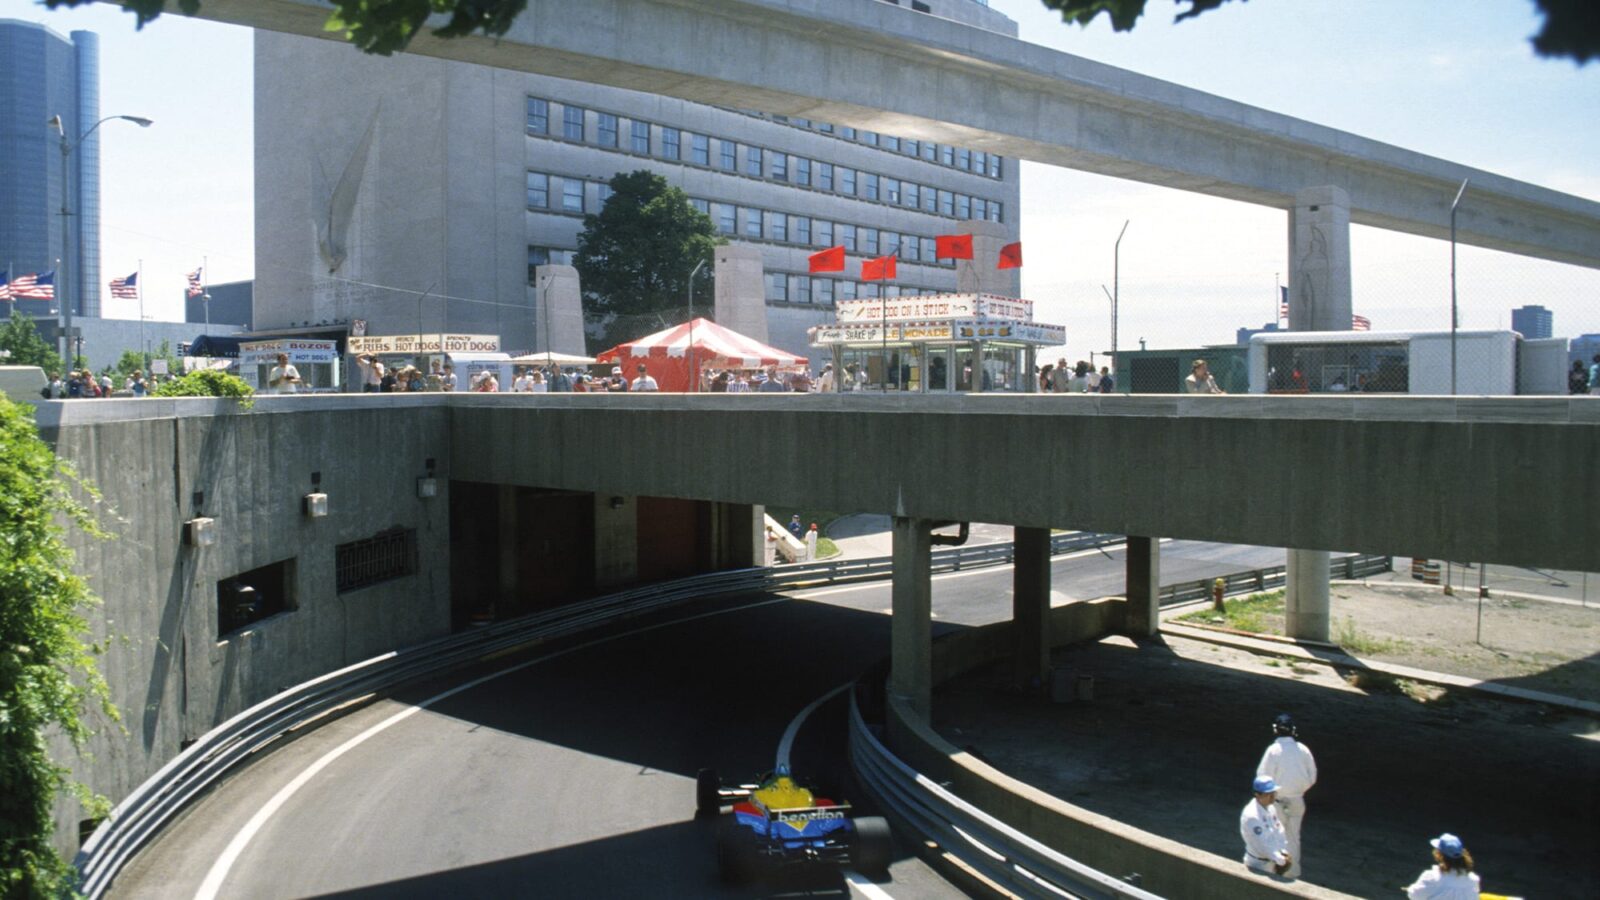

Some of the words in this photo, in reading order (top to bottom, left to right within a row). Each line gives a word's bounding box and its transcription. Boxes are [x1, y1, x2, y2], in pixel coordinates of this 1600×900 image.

[902, 305, 912, 316] ON
[915, 305, 921, 316] A
[924, 303, 949, 315] STICK
[846, 329, 866, 341] SHAKE
[867, 329, 877, 341] UP
[363, 342, 390, 352] RIBS
[395, 342, 413, 351] HOT
[415, 341, 441, 350] DOGS
[445, 341, 468, 350] HOT
[470, 341, 497, 350] DOGS
[779, 808, 845, 822] benetton
